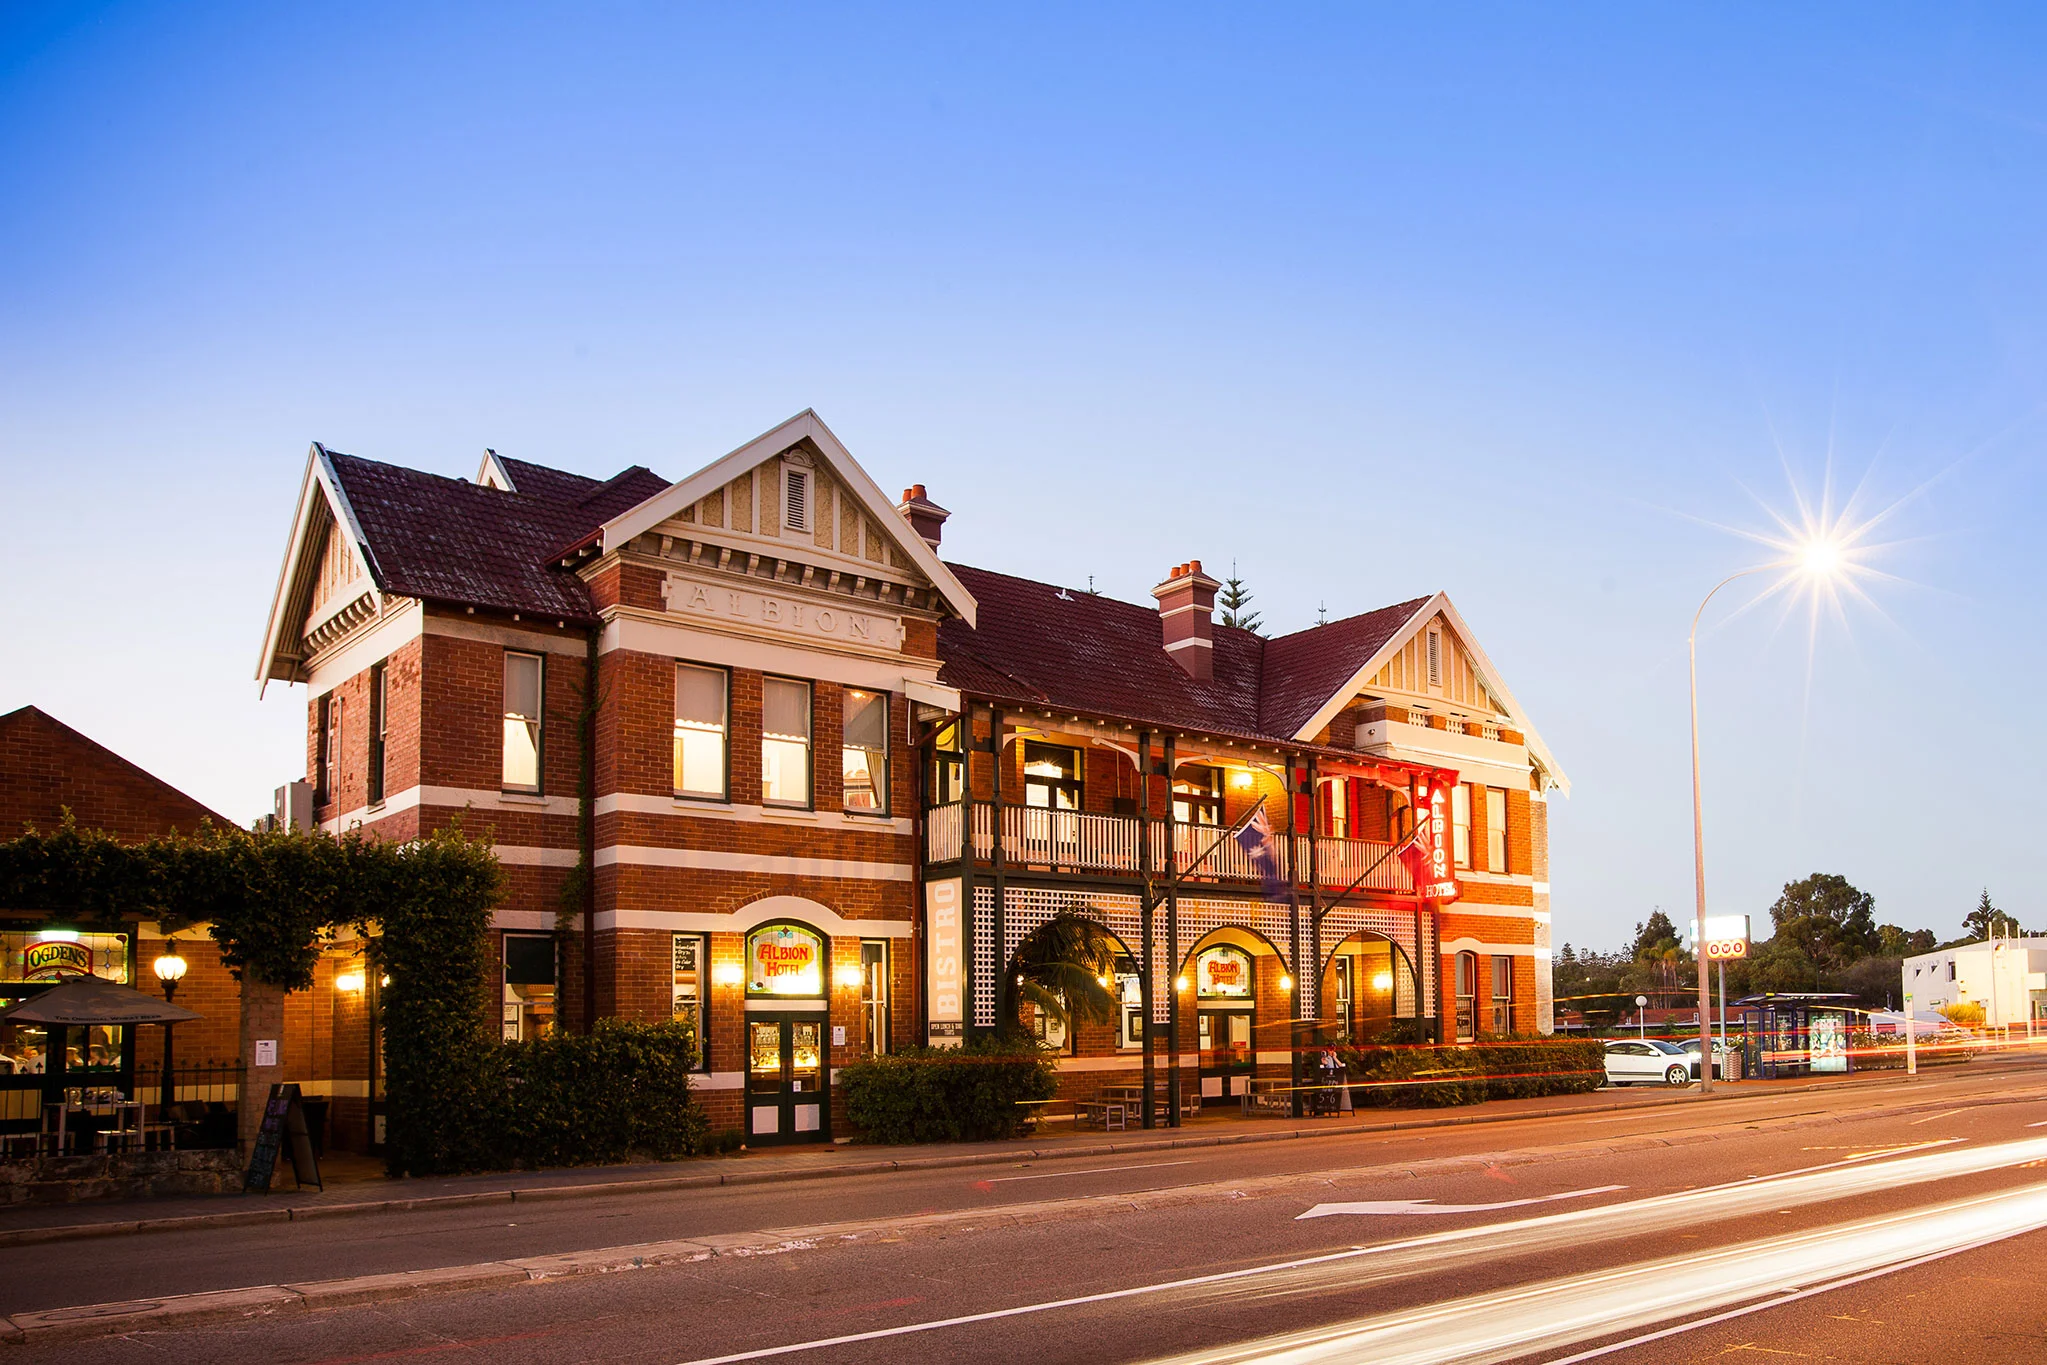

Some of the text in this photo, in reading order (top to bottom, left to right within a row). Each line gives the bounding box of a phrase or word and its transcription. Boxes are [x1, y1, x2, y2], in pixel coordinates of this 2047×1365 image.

[1431, 788, 1447, 878] ALBION
[1426, 881, 1456, 898] HOTEL
[30, 945, 87, 968] OGDENS
[759, 943, 809, 960] ALBION
[934, 882, 959, 1015] BISTRO
[1711, 943, 1741, 953] BWS
[1209, 961, 1237, 973] ALBION
[1212, 974, 1234, 985] HOTEL
